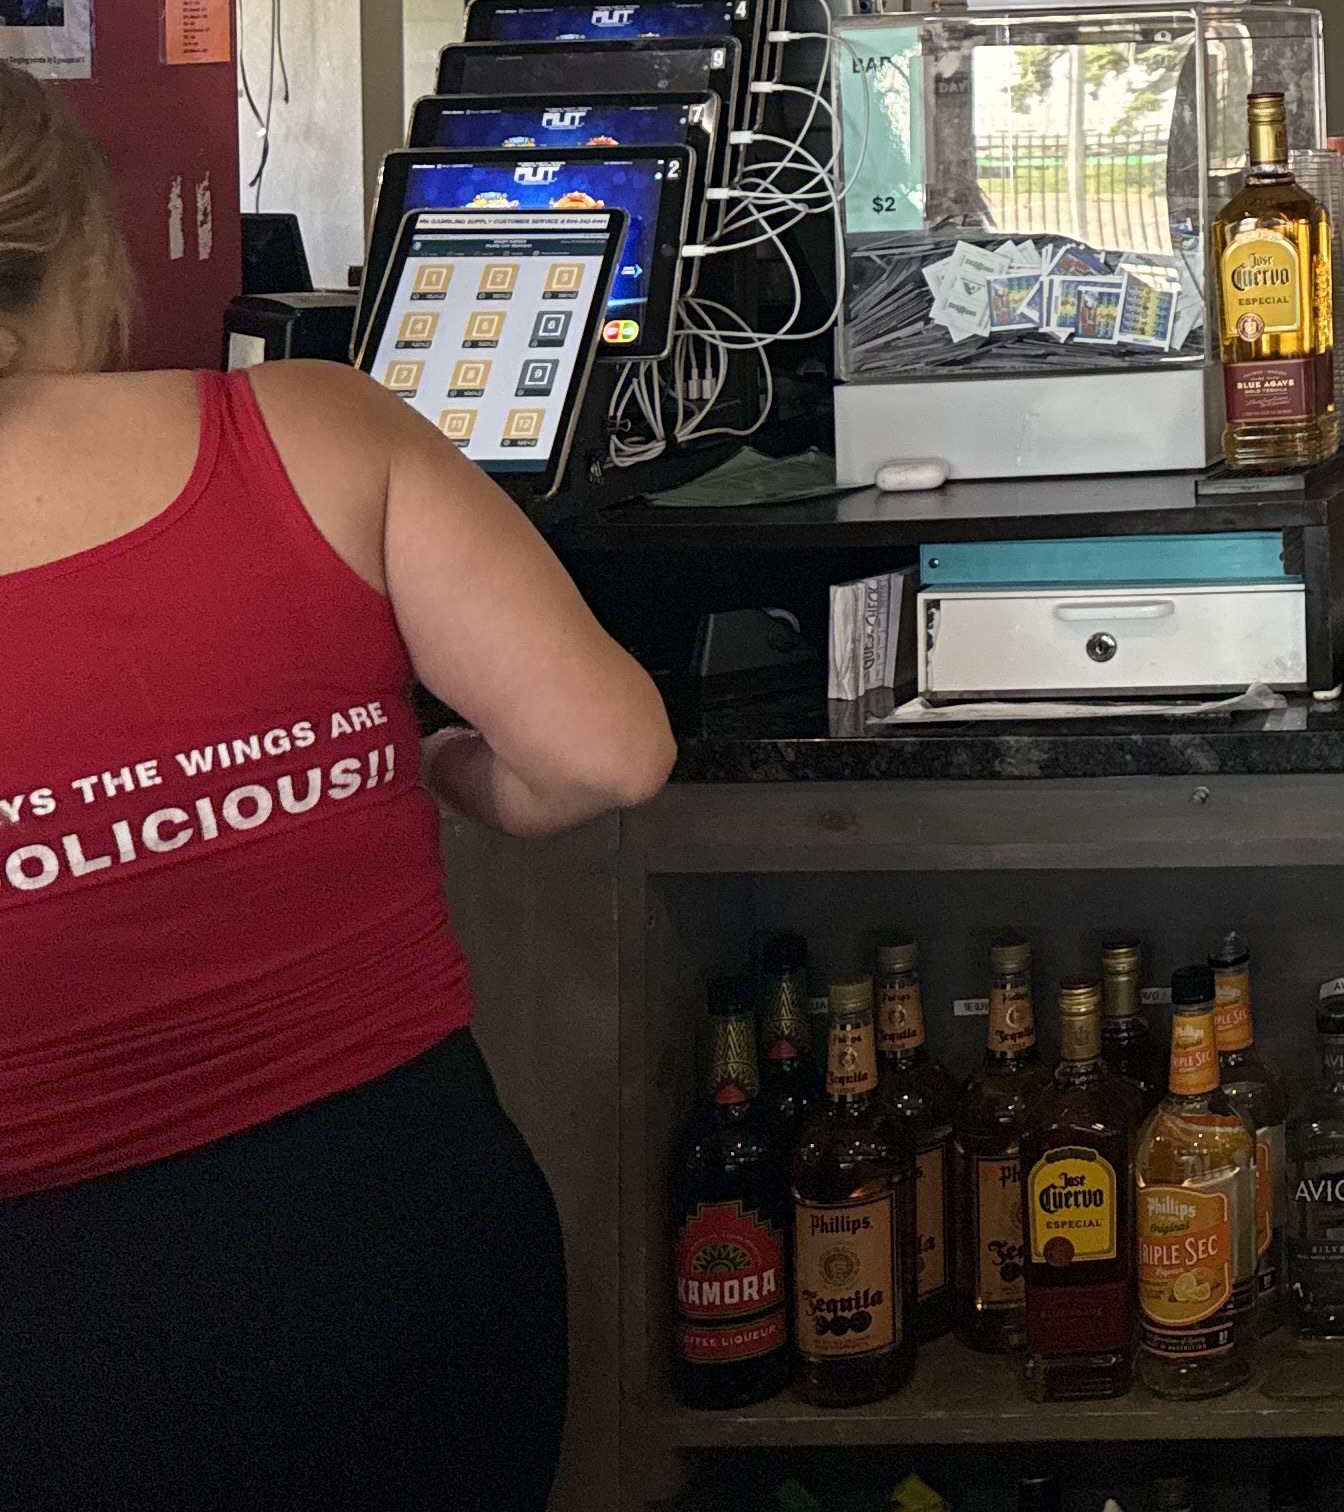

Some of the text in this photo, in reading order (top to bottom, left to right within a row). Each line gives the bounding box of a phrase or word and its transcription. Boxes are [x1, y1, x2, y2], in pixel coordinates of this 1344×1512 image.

[735, 2, 746, 17] 4
[712, 50, 724, 67] 9
[668, 161, 679, 178] 2
[872, 194, 897, 214] $2
[1231, 264, 1290, 292] Cuervo
[1238, 296, 1290, 306] ESPECIAL
[1236, 377, 1296, 389] BLUE AGAVE
[71, 759, 163, 804] THE
[175, 720, 316, 778] WINGS
[330, 701, 388, 740] ARE
[5, 744, 396, 891] OLICIOUS!!
[1038, 1185, 1104, 1214] Cuervo
[1147, 1194, 1197, 1218] Phillips
[1046, 1218, 1103, 1230] ESPECIAL
[677, 1269, 776, 1306] KAMORA
[805, 1289, 886, 1317] Tequila
[721, 1325, 777, 1347] LIQUEUR
